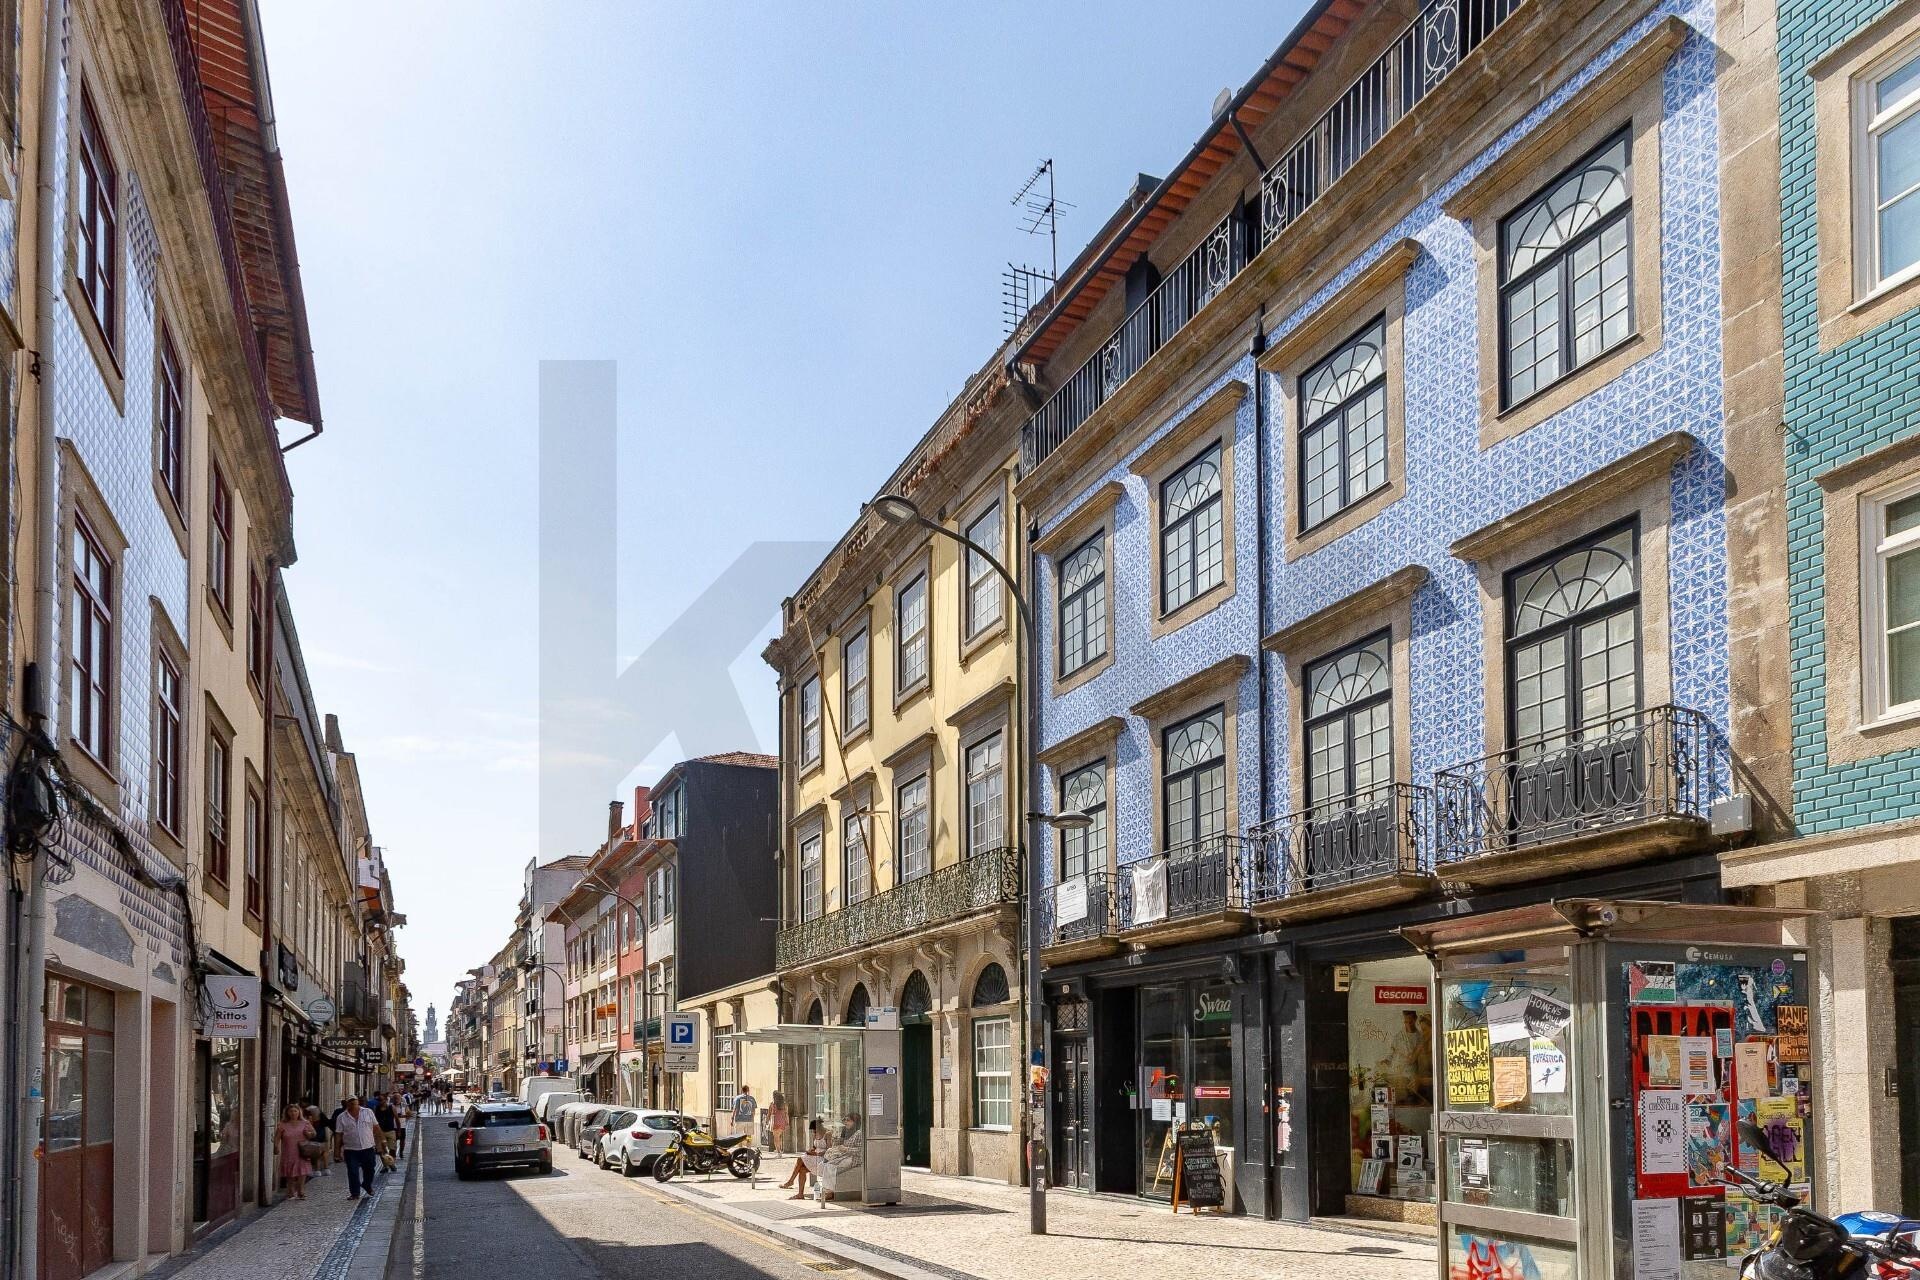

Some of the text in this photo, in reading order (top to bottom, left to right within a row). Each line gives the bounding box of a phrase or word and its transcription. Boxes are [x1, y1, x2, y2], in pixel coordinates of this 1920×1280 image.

[1528, 995, 1563, 1016] HOMENS
[216, 1010, 248, 1021] Rittos
[1779, 1007, 1807, 1023] MANIF
[675, 1025, 689, 1042] P
[1447, 1028, 1488, 1052] MANIF
[327, 1038, 369, 1047] LIVRARIA
[1450, 1083, 1489, 1096] DOM 29
